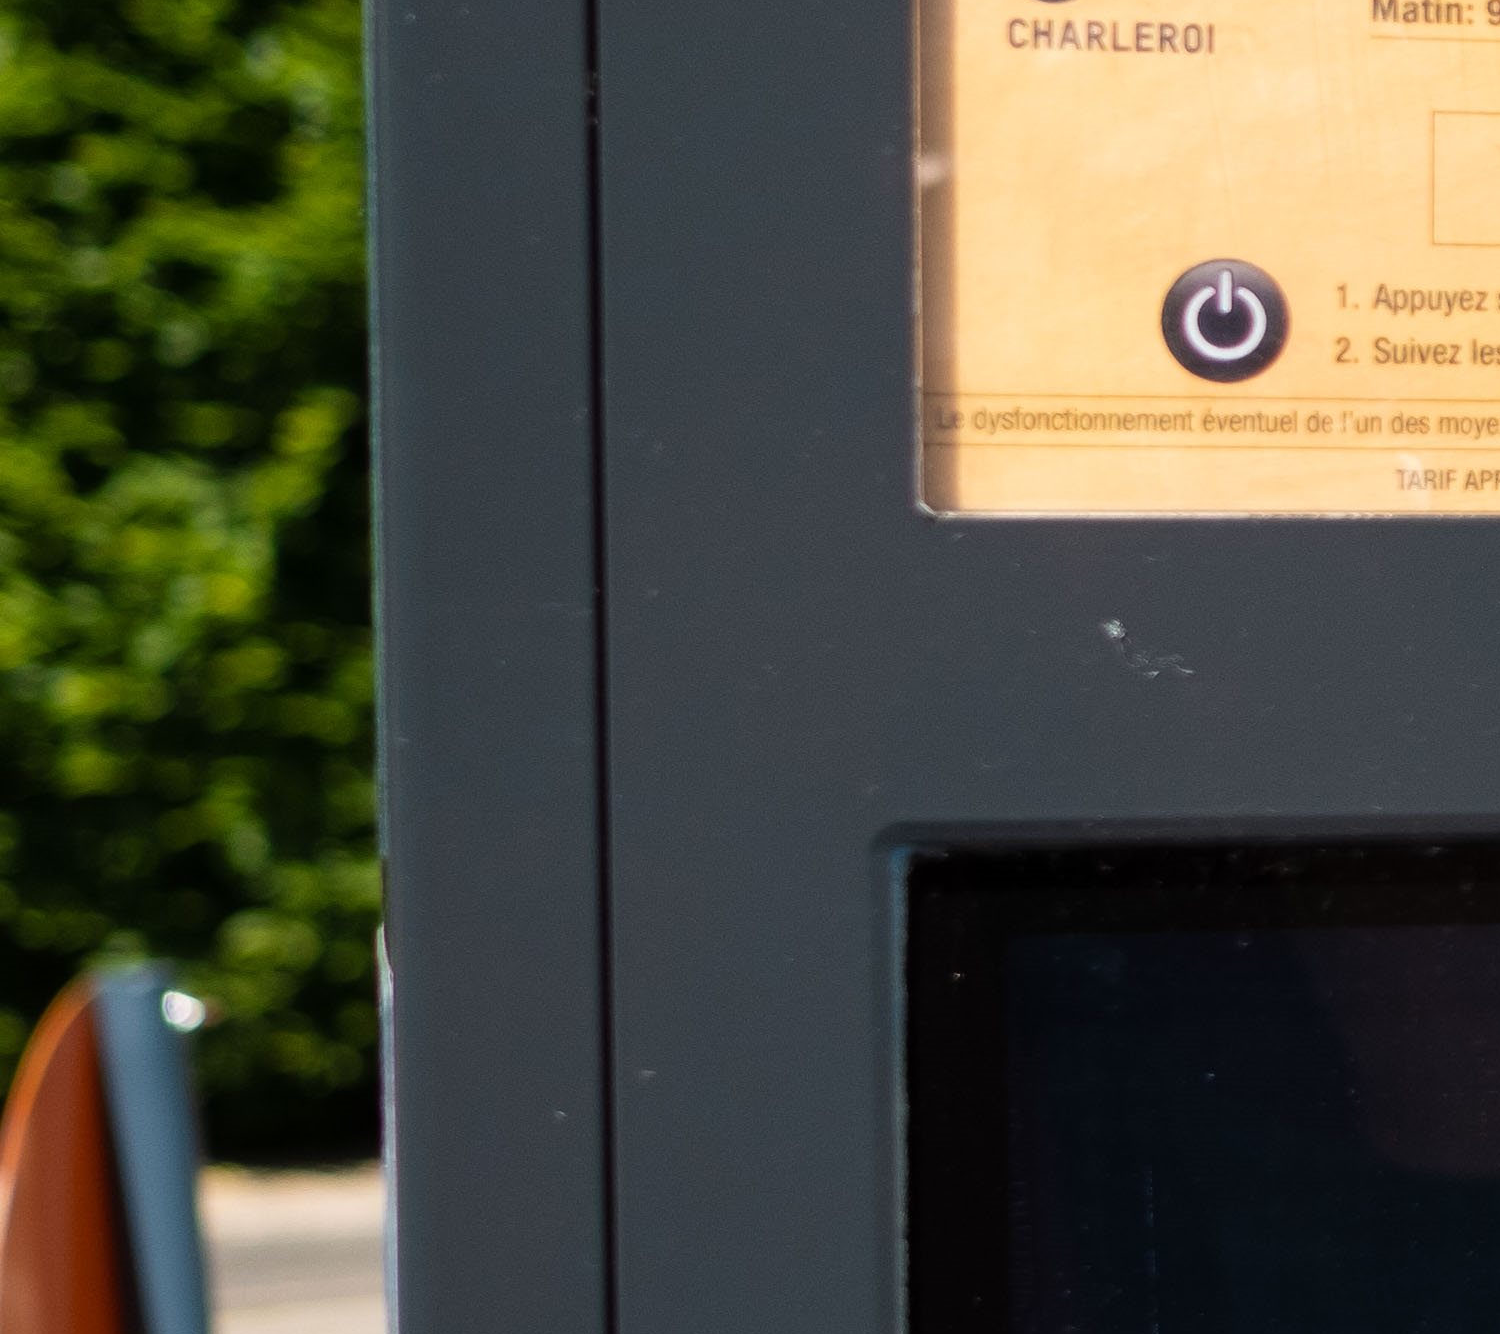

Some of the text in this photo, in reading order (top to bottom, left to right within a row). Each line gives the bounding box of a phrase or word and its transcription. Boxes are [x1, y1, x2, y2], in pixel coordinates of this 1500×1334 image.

[1008, 17, 1215, 54] CHARLEROI
[1336, 283, 1359, 310] 1.
[1373, 284, 1489, 316] Appuyez
[1335, 339, 1358, 364] 2.
[1373, 339, 1463, 365] Suivez
[938, 406, 965, 431] Le
[973, 406, 1194, 435] dysfonctionnement
[1202, 407, 1298, 434] éventuel
[1307, 411, 1334, 434] de
[1342, 410, 1383, 435] l'un
[1391, 411, 1431, 435] des
[1396, 468, 1457, 492] TARIF
